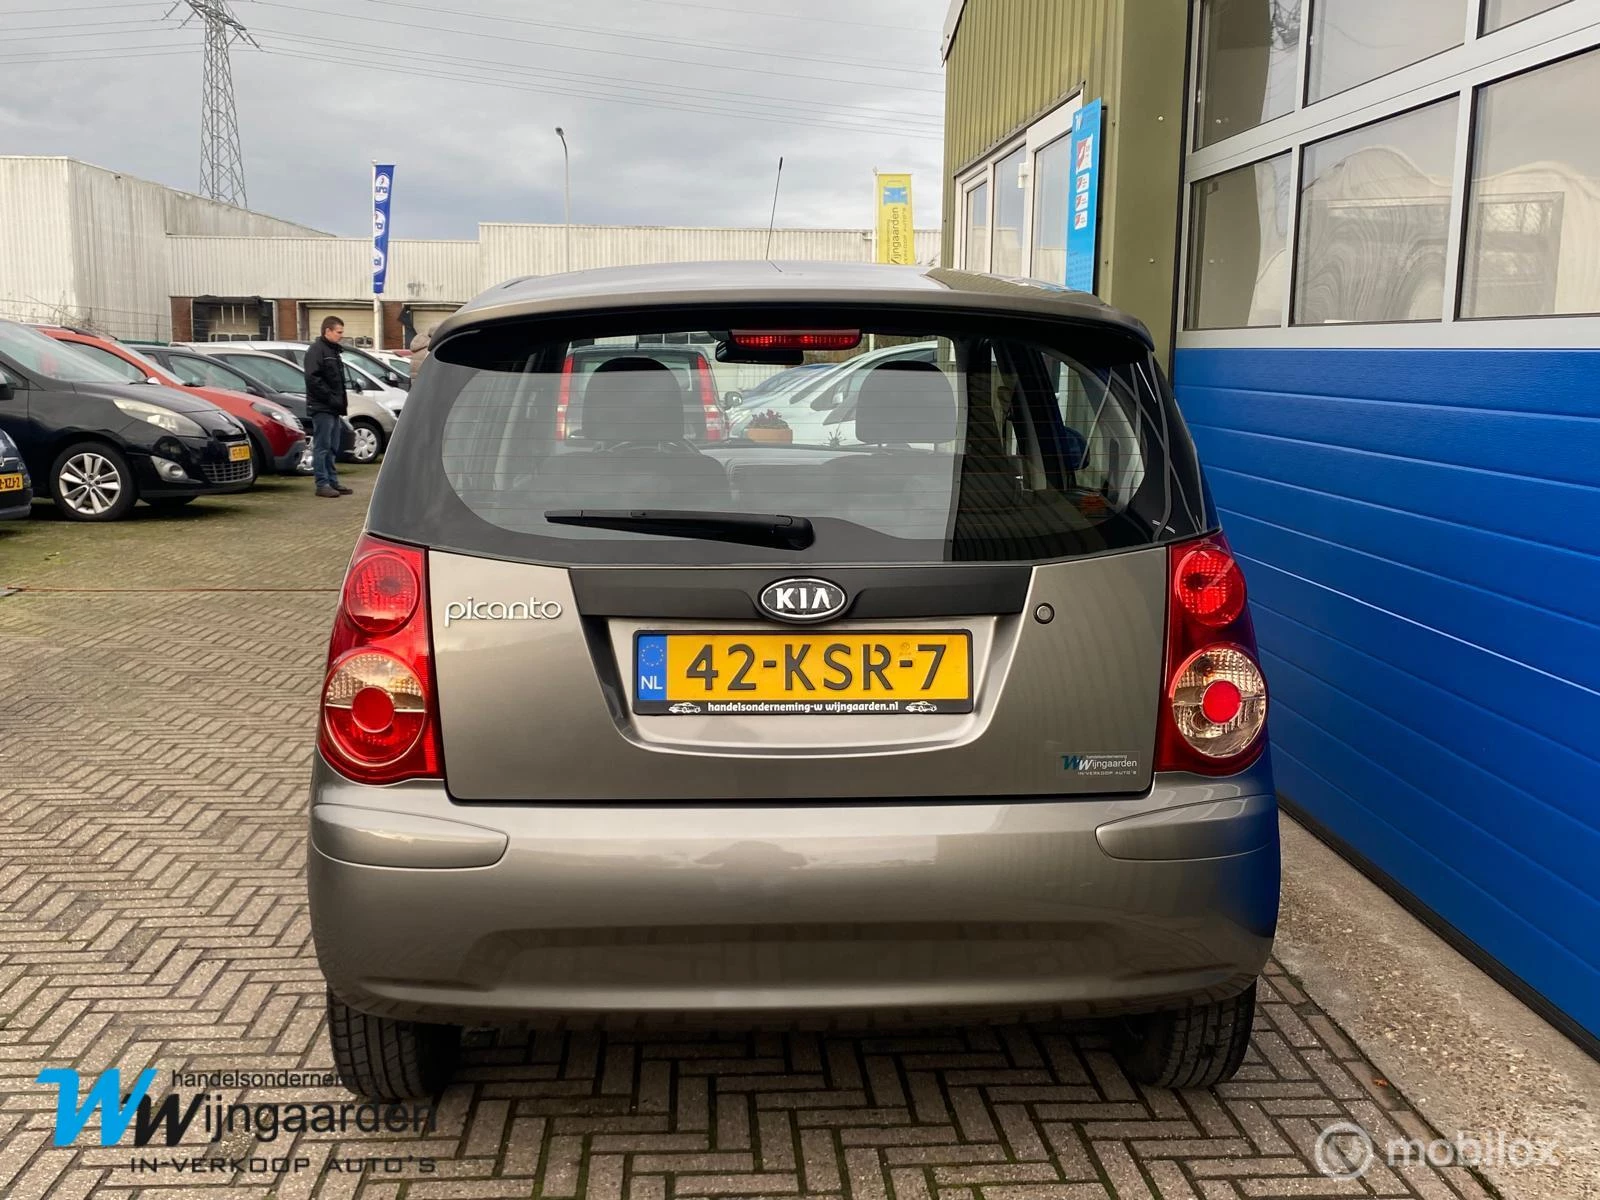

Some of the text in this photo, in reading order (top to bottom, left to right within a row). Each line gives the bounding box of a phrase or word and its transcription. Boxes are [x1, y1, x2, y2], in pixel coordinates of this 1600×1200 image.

[776, 587, 833, 610] KIA
[445, 596, 563, 627] picanto
[685, 642, 947, 692] 42-KSR-7
[640, 674, 663, 691] NL
[707, 701, 899, 713] handelsonderneming-w wijngaarden.nl
